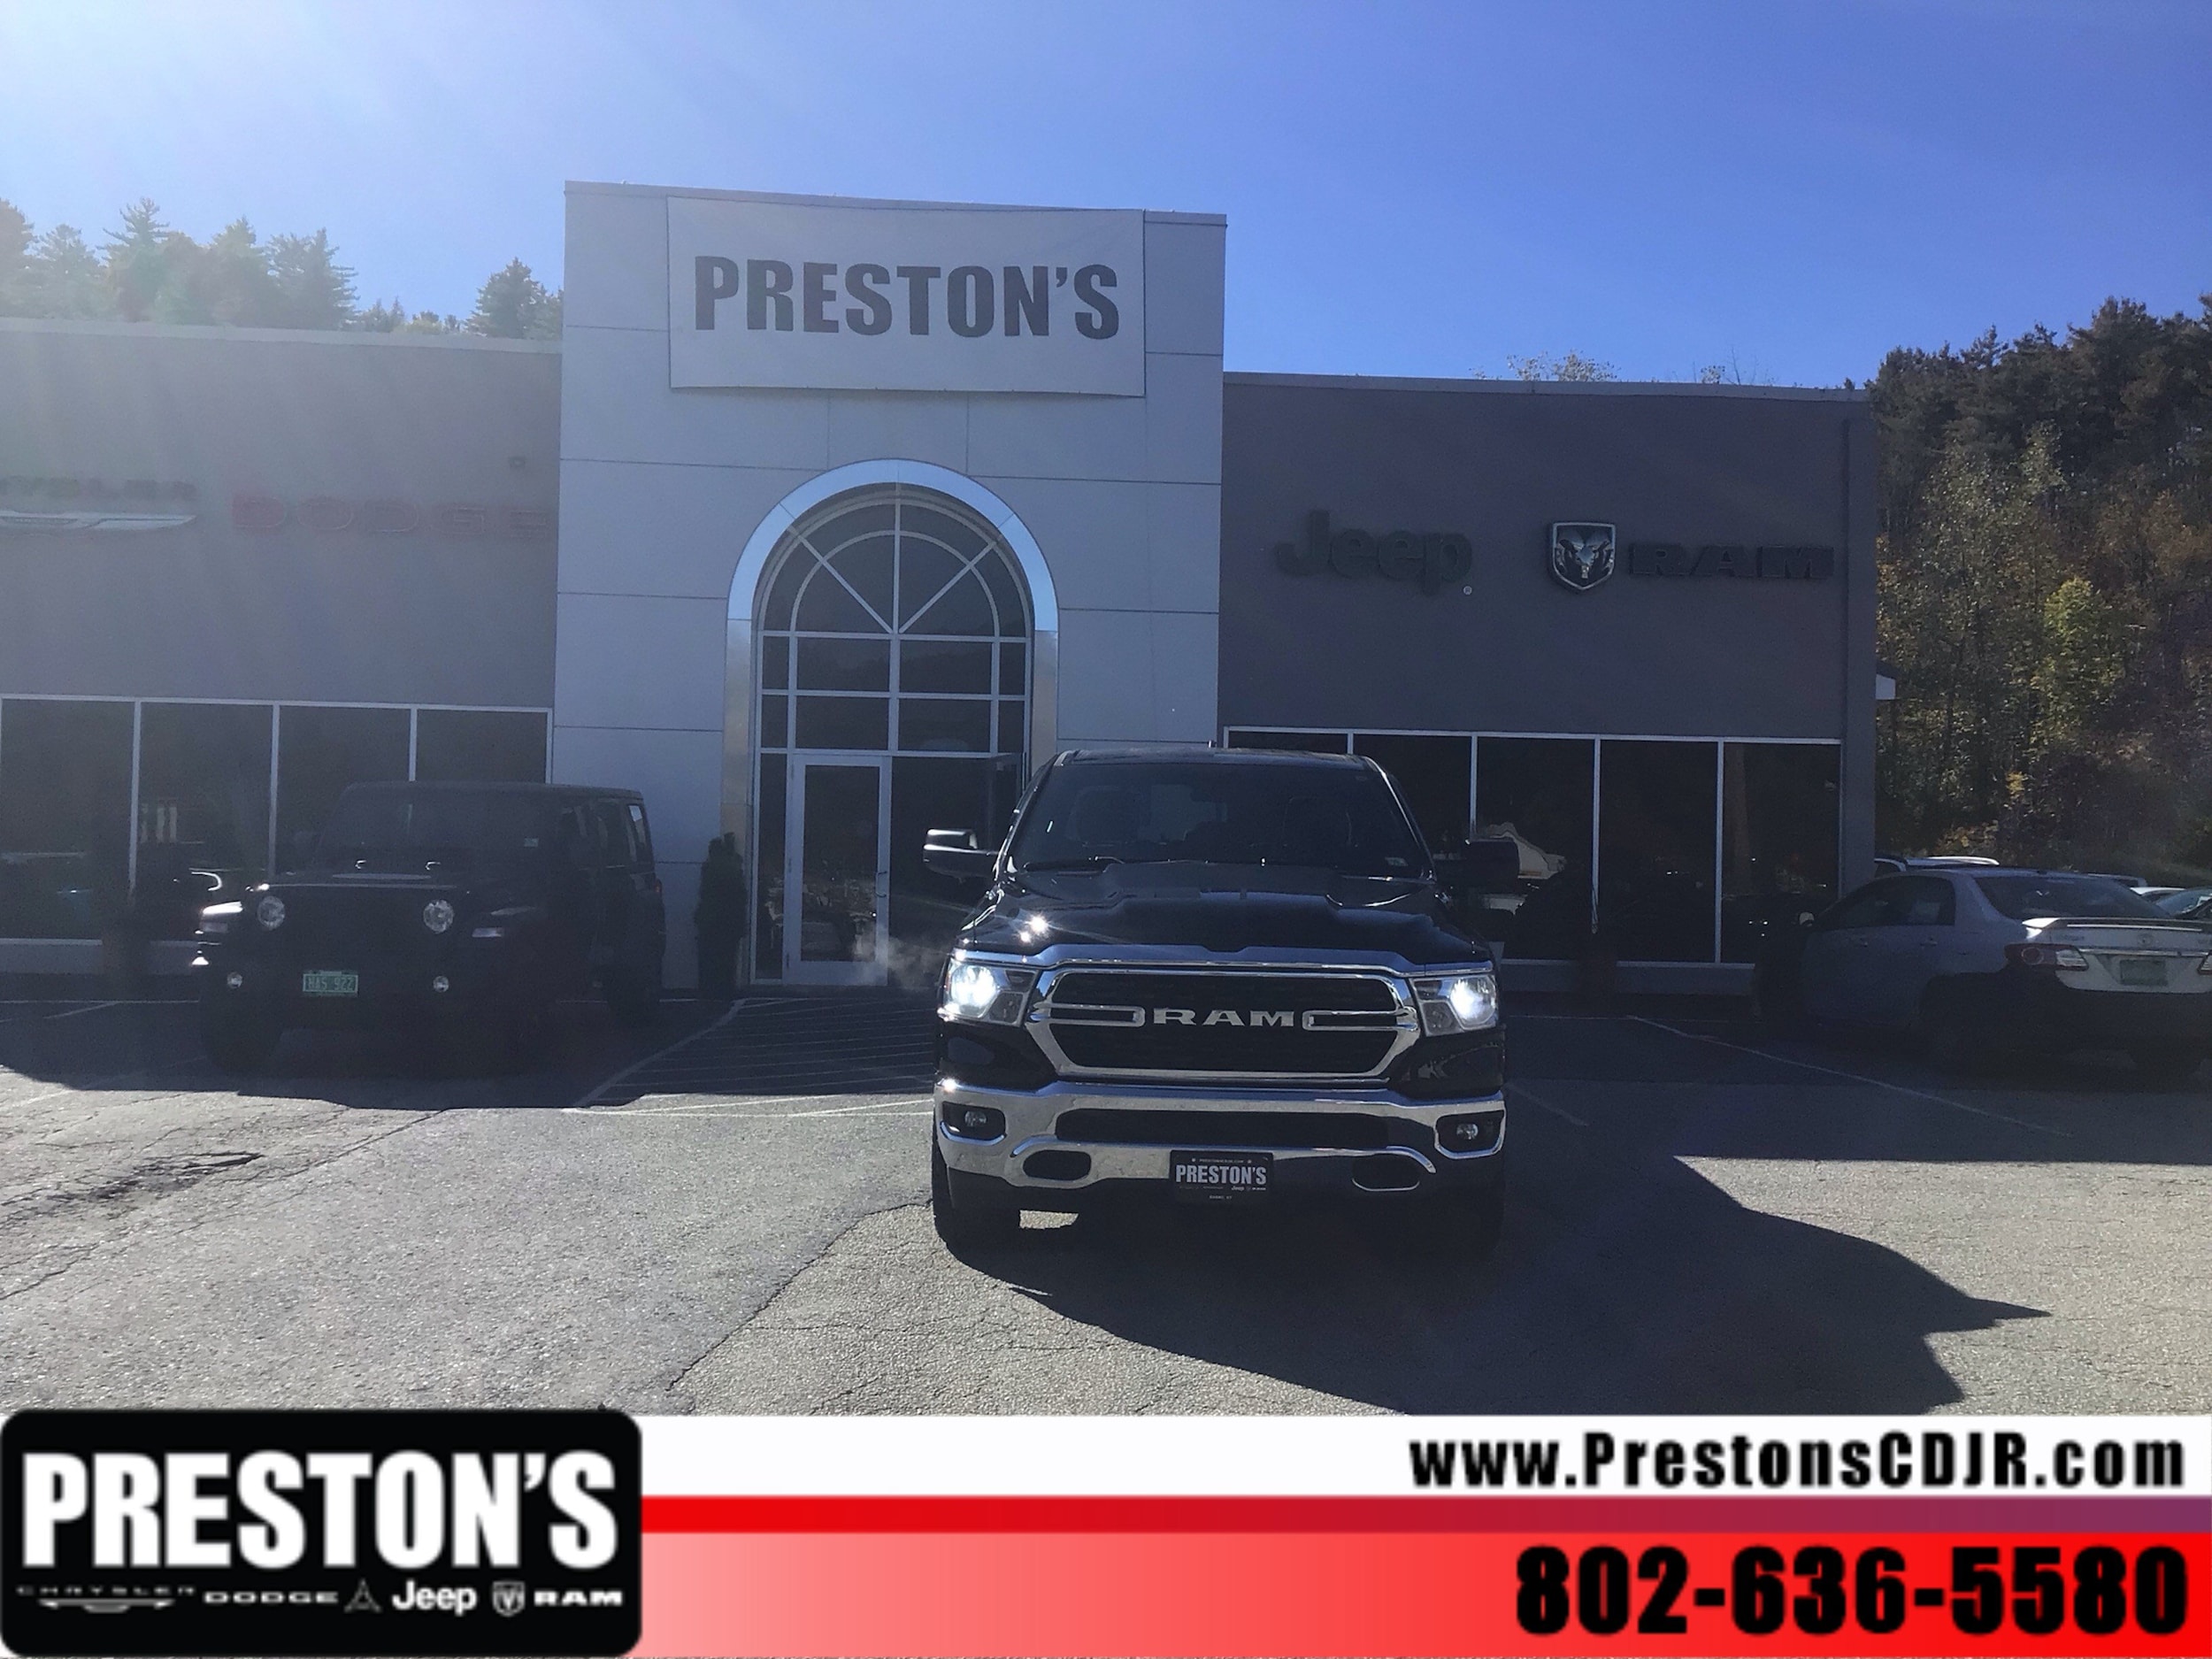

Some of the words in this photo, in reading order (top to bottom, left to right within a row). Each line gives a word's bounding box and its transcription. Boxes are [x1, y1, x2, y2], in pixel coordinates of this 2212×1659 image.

[695, 255, 1119, 340] PRESTON'S
[232, 495, 551, 538] DODGE
[1275, 509, 1472, 596] Jeep
[1628, 542, 1835, 580] RAM
[1153, 1008, 1294, 1027] RAM
[1175, 1164, 1267, 1185] PRESTON'S
